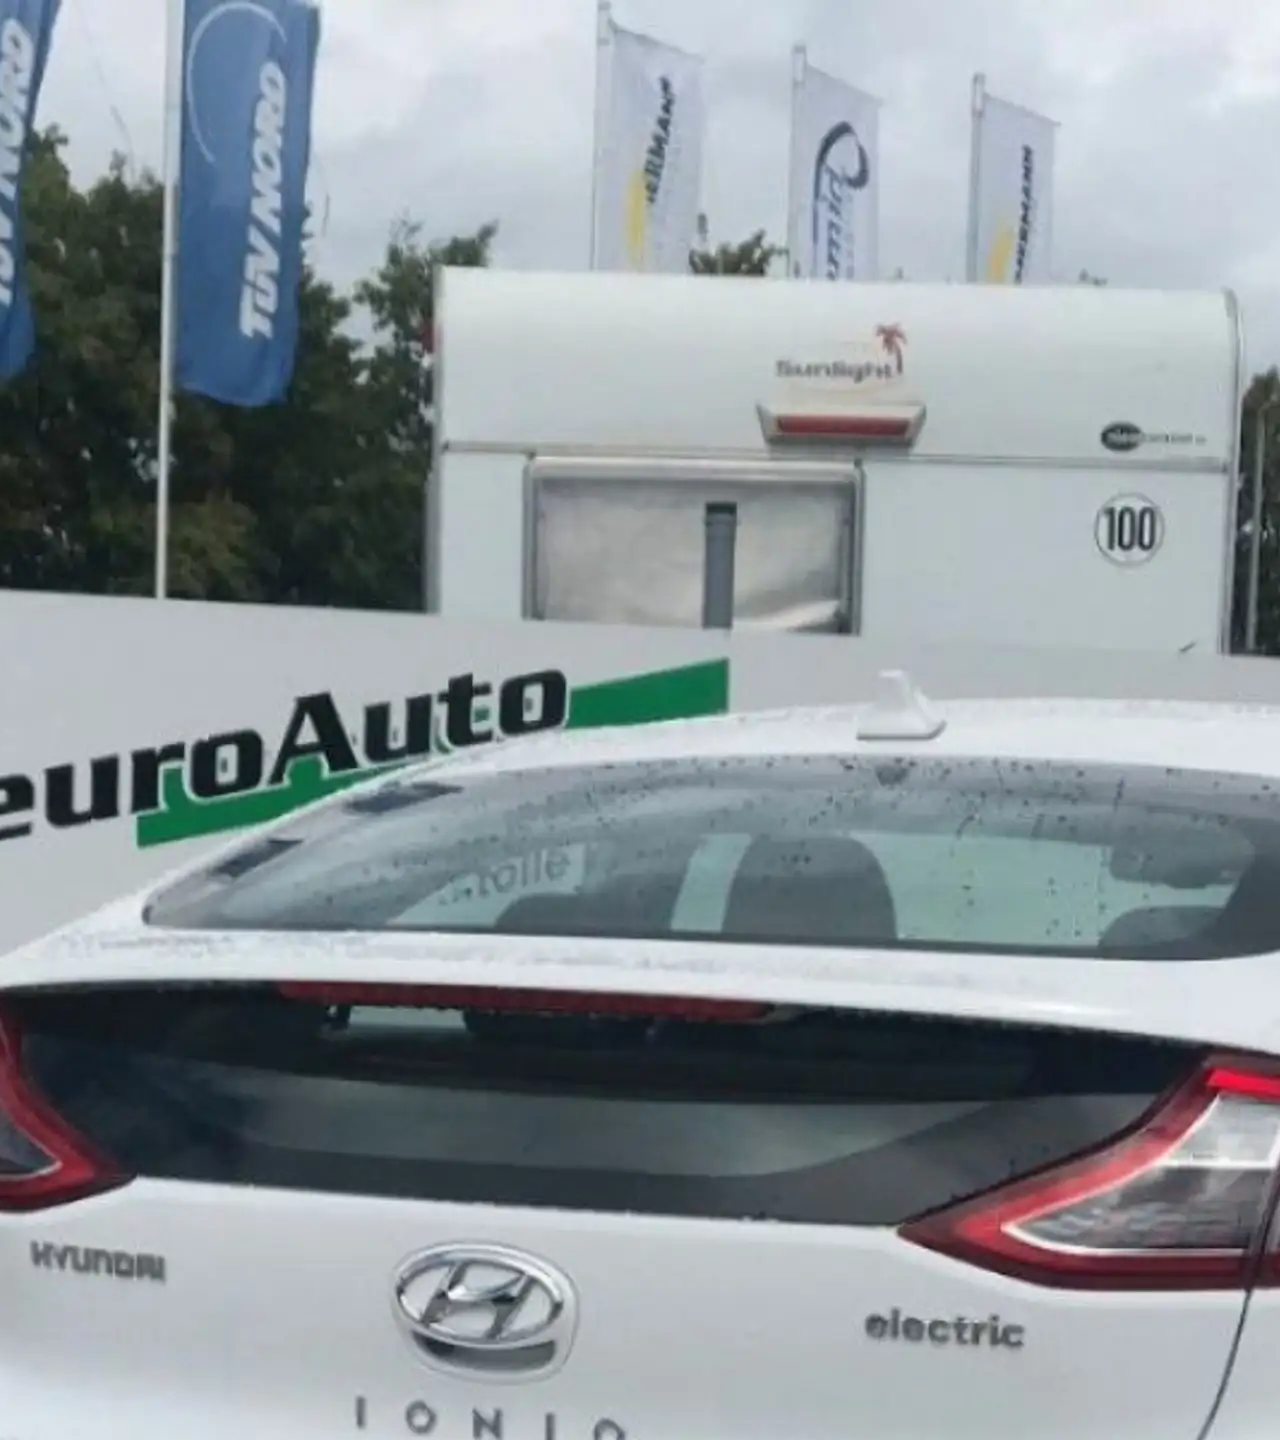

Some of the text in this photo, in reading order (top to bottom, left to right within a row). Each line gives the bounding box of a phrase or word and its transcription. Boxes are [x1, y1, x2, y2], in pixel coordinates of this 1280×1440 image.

[250, 60, 287, 238] NORD
[1102, 504, 1158, 553] 100
[29, 1240, 167, 1284] HYUNDAI
[864, 1307, 1025, 1348] electric
